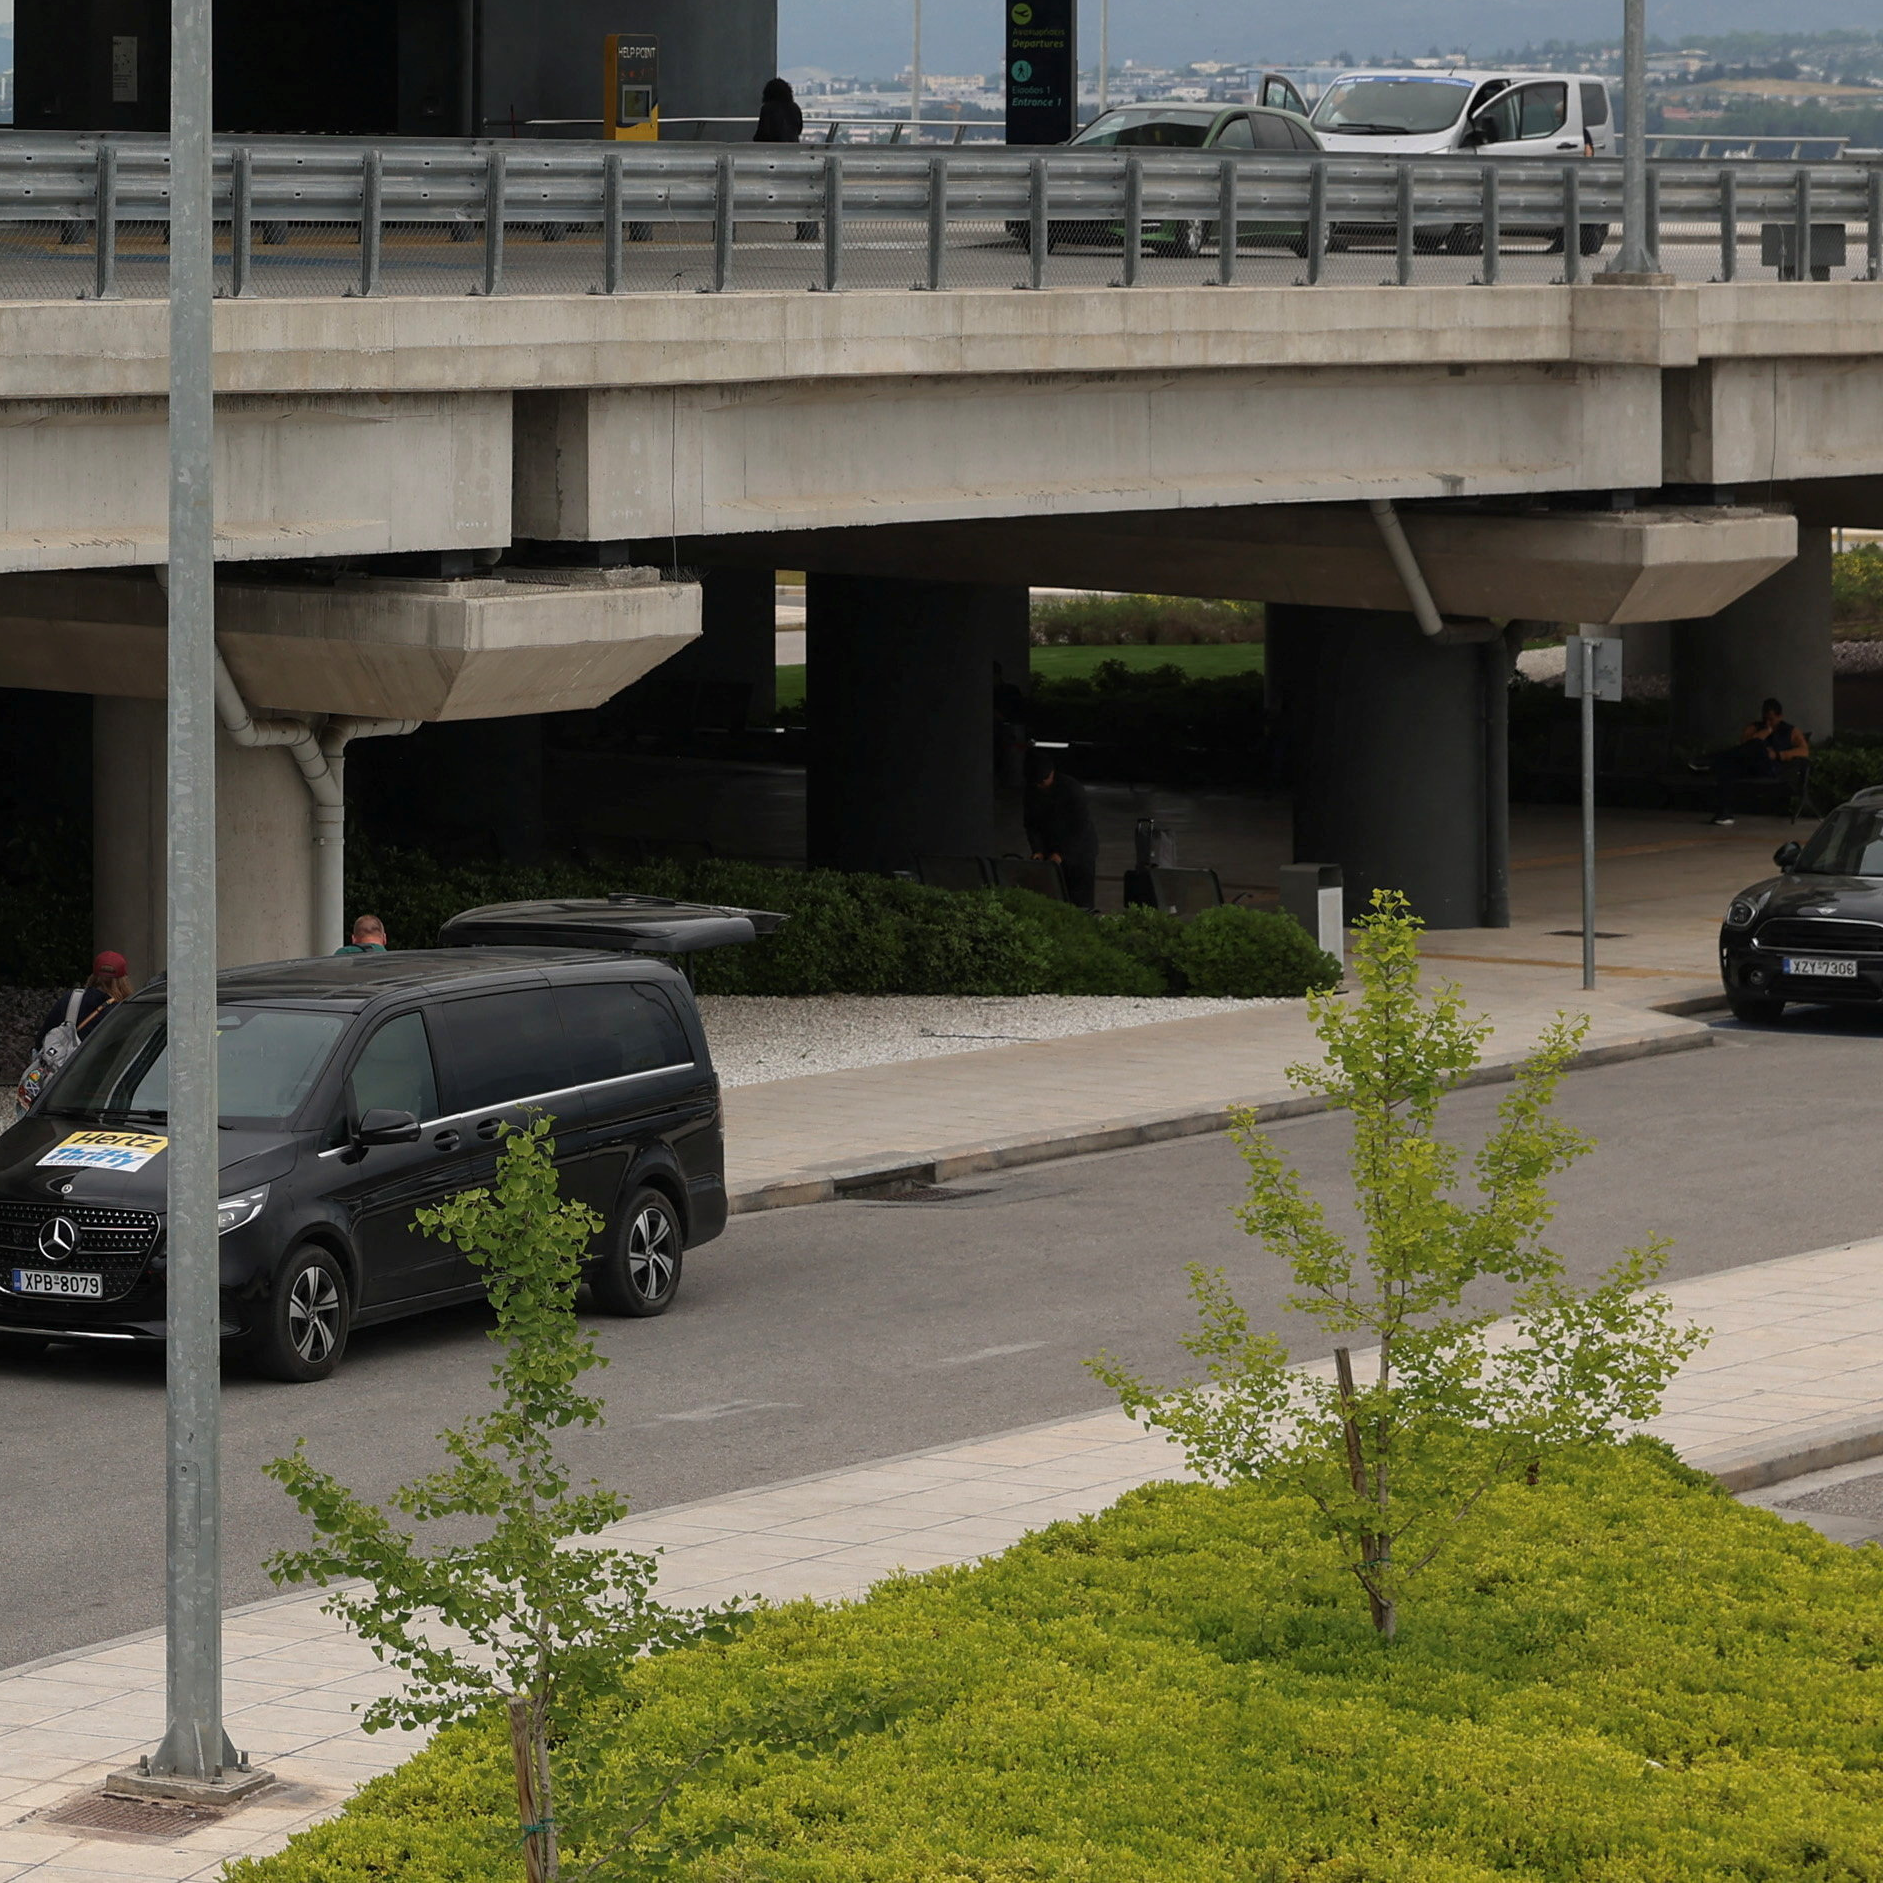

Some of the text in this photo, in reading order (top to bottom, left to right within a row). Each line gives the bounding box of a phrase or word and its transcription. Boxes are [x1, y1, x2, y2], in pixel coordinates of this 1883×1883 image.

[1012, 38, 1064, 49] Departures
[618, 46, 635, 58] HELP
[1012, 97, 1062, 107] Entrance 1
[72, 1132, 163, 1148] Hertz
[25, 1273, 99, 1294] XPB-8079
